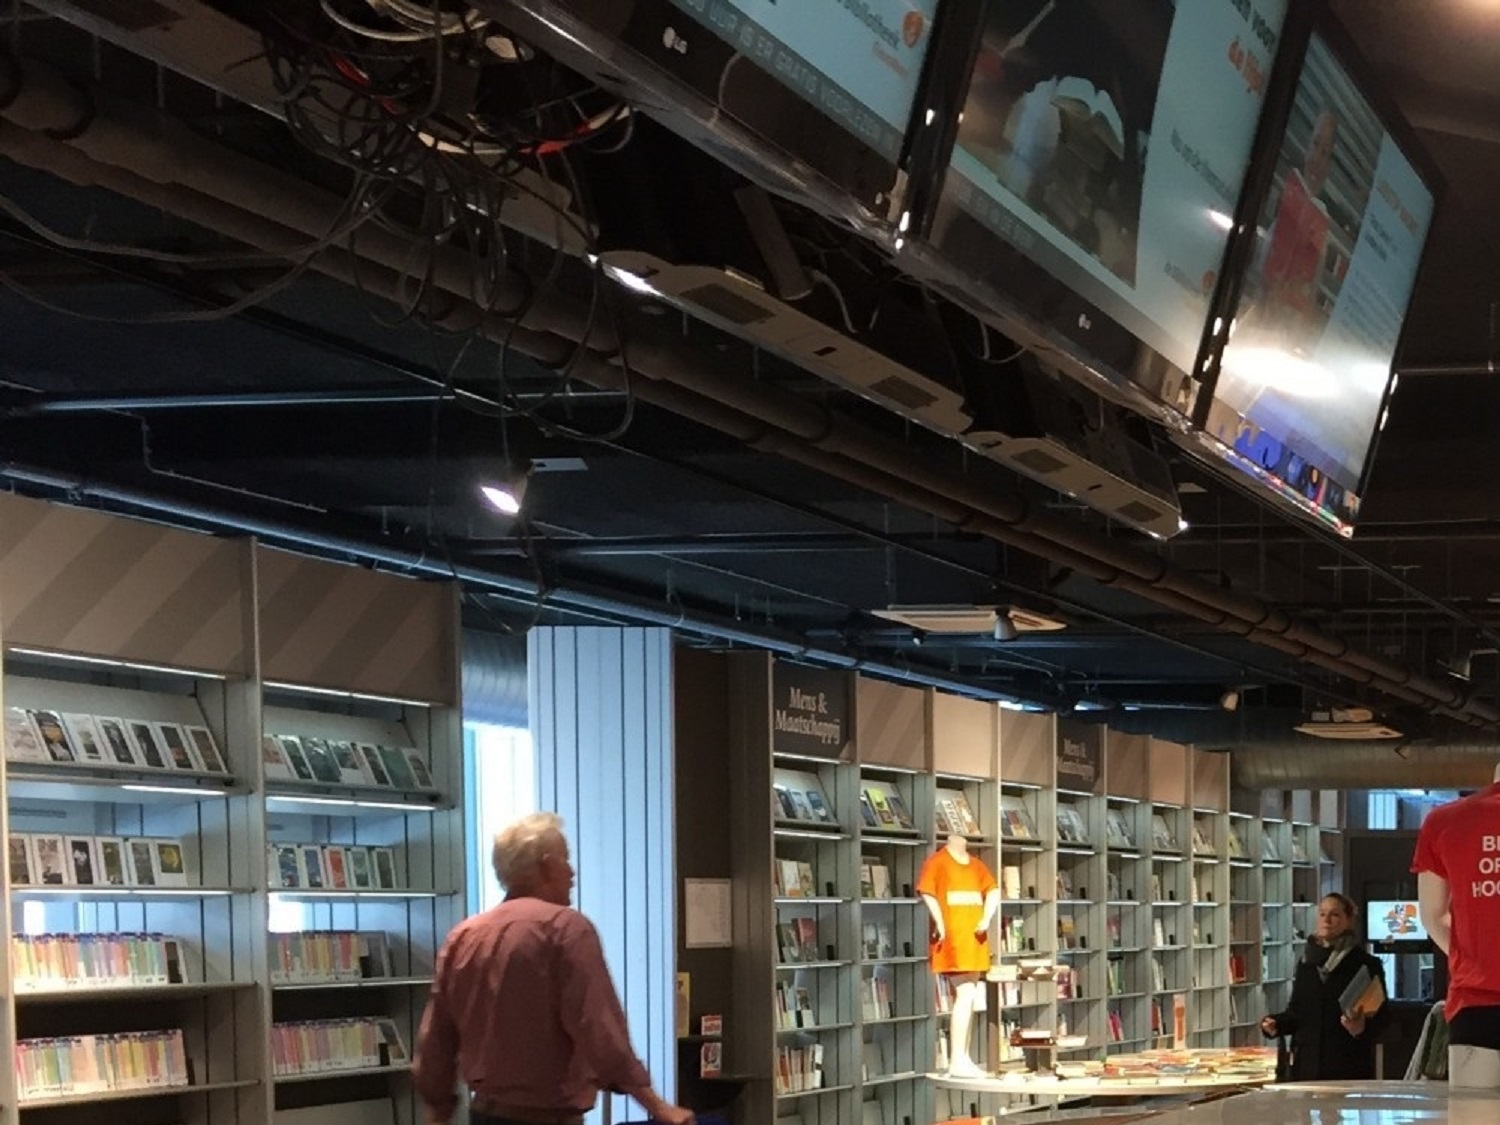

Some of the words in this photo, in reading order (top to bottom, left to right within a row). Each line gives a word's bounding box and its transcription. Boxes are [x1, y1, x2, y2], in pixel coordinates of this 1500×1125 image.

[789, 687, 816, 711] Mens
[818, 692, 828, 714] &
[775, 709, 840, 744] Maatschappij
